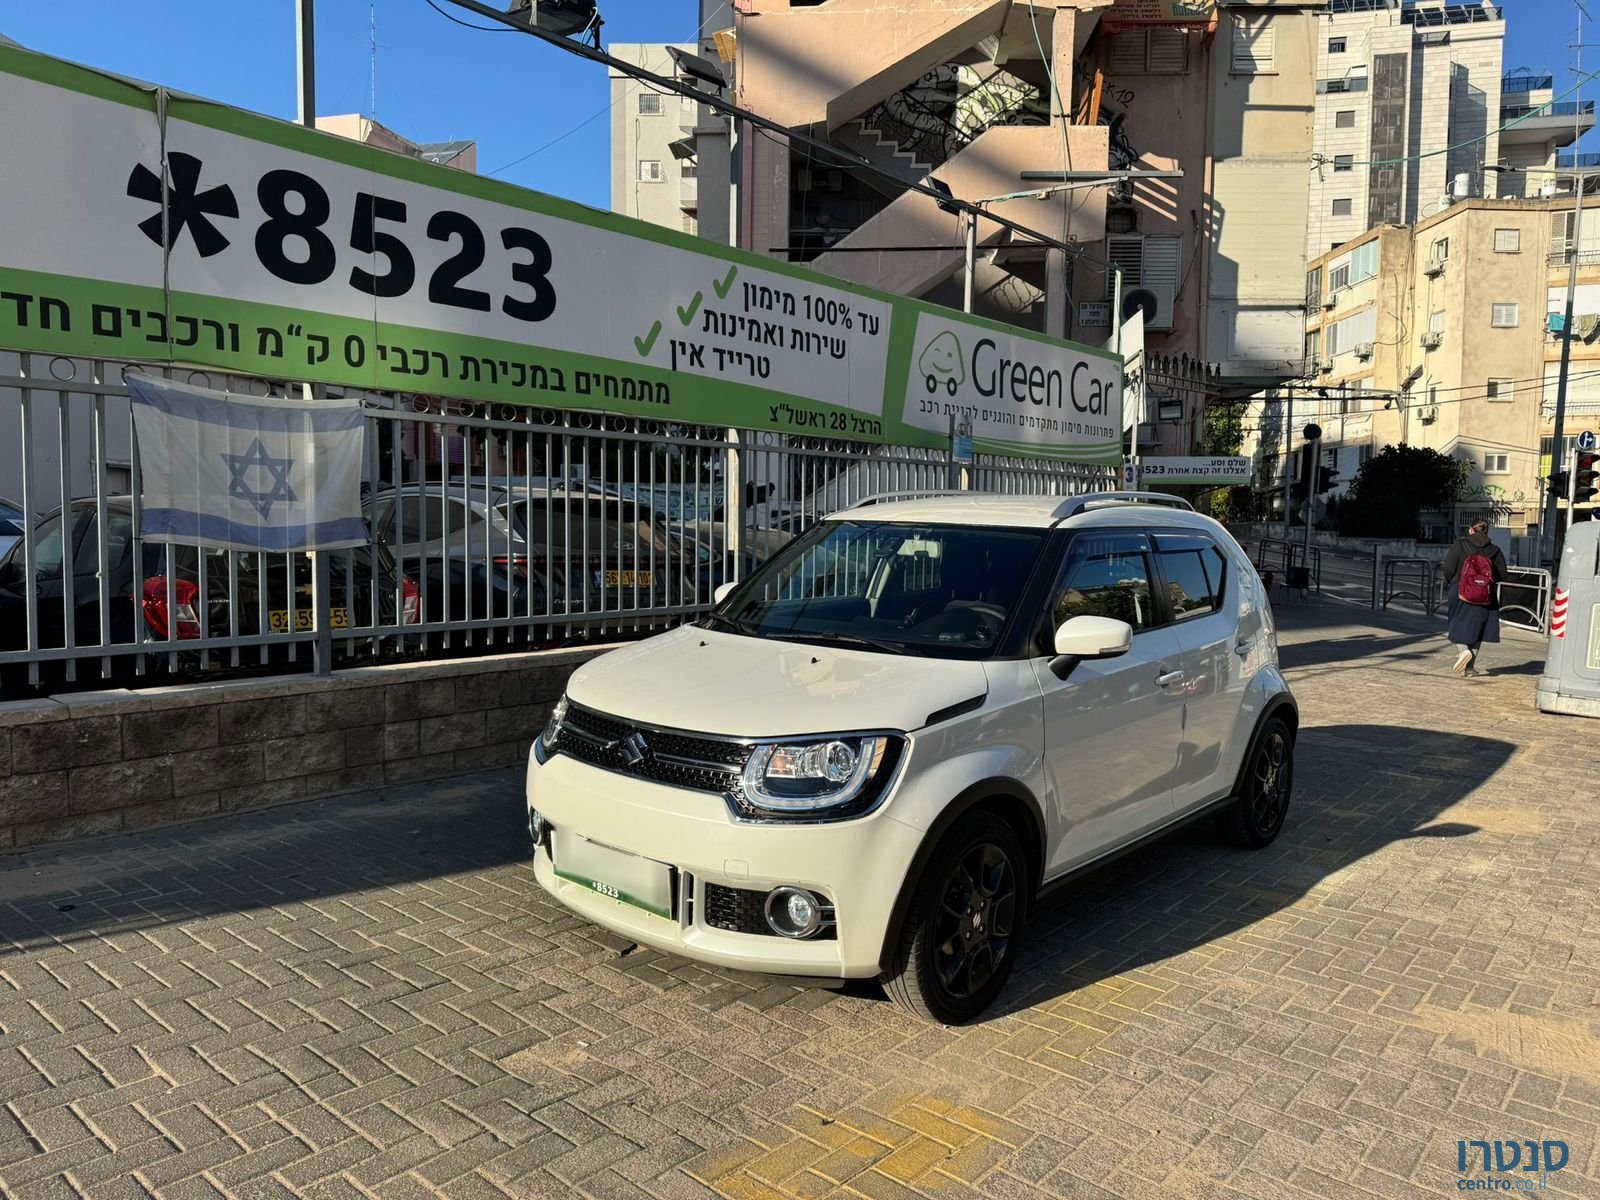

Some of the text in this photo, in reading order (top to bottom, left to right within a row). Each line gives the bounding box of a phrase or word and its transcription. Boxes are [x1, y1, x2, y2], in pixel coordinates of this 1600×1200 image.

[743, 281, 880, 336] עד 100% מימון
[91, 303, 240, 353] ורכבים
[702, 308, 846, 359] שירות ואמינות
[344, 334, 365, 368] 0
[376, 344, 449, 378] רכבי
[669, 339, 770, 379] טרייד אין
[459, 355, 566, 391] במכירת
[971, 338, 1114, 416] Green Car
[574, 371, 671, 404] מתמחים
[920, 399, 940, 414] רכב
[982, 409, 1016, 425] והוגנים
[830, 411, 847, 431] 28
[850, 413, 882, 436] הרצל
[1019, 415, 1058, 432] מתקדמים
[1061, 421, 1082, 436] מימון
[1084, 422, 1114, 439] פתרונות
[1192, 467, 1209, 476] קצת
[1211, 466, 1221, 474] זה
[1223, 466, 1246, 474] אצלנו
